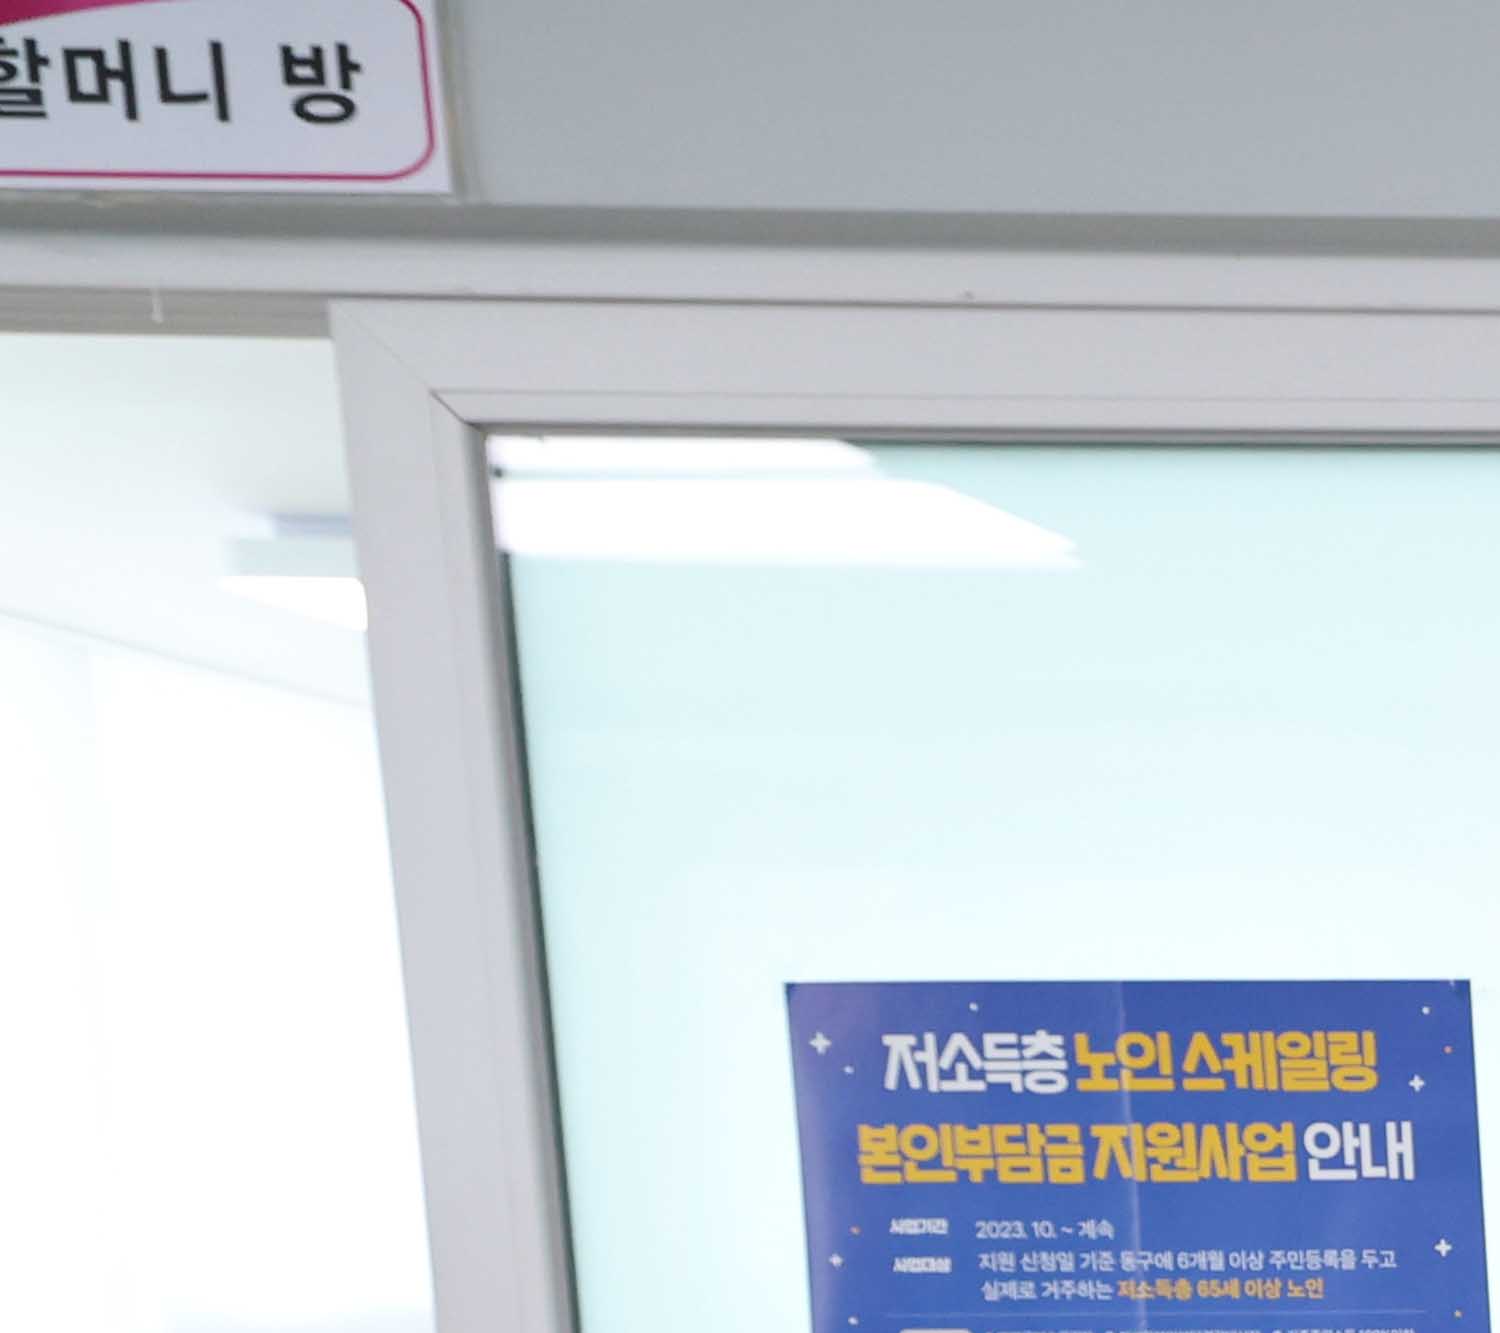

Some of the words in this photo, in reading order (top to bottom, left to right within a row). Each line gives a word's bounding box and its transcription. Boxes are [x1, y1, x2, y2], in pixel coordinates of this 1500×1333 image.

[0, 36, 231, 123] 할머니
[279, 41, 363, 125] 방
[882, 1030, 1069, 1093] 저소득층
[1075, 1030, 1175, 1091] 노인
[1183, 1029, 1379, 1092] 스케일링
[857, 1124, 1085, 1184] 본인부담금
[1092, 1122, 1296, 1183] 지원사업
[1302, 1121, 1416, 1181] 안내
[1078, 1219, 1115, 1241] 계속
[979, 1252, 1015, 1273] 지원
[1020, 1251, 1076, 1273] 신청일
[1080, 1251, 1116, 1272] 기준
[1120, 1250, 1175, 1272] 동구에
[1177, 1249, 1225, 1272] 6개월
[1229, 1249, 1265, 1271] 이상
[1361, 1249, 1397, 1270] 두고
[981, 1280, 1038, 1302] 실제로
[1041, 1279, 1113, 1301] 거주하는
[1117, 1279, 1193, 1301] 저소득층
[1196, 1278, 1241, 1299] 65세
[1244, 1278, 1281, 1299] 이상
[1286, 1277, 1326, 1299] 노인
